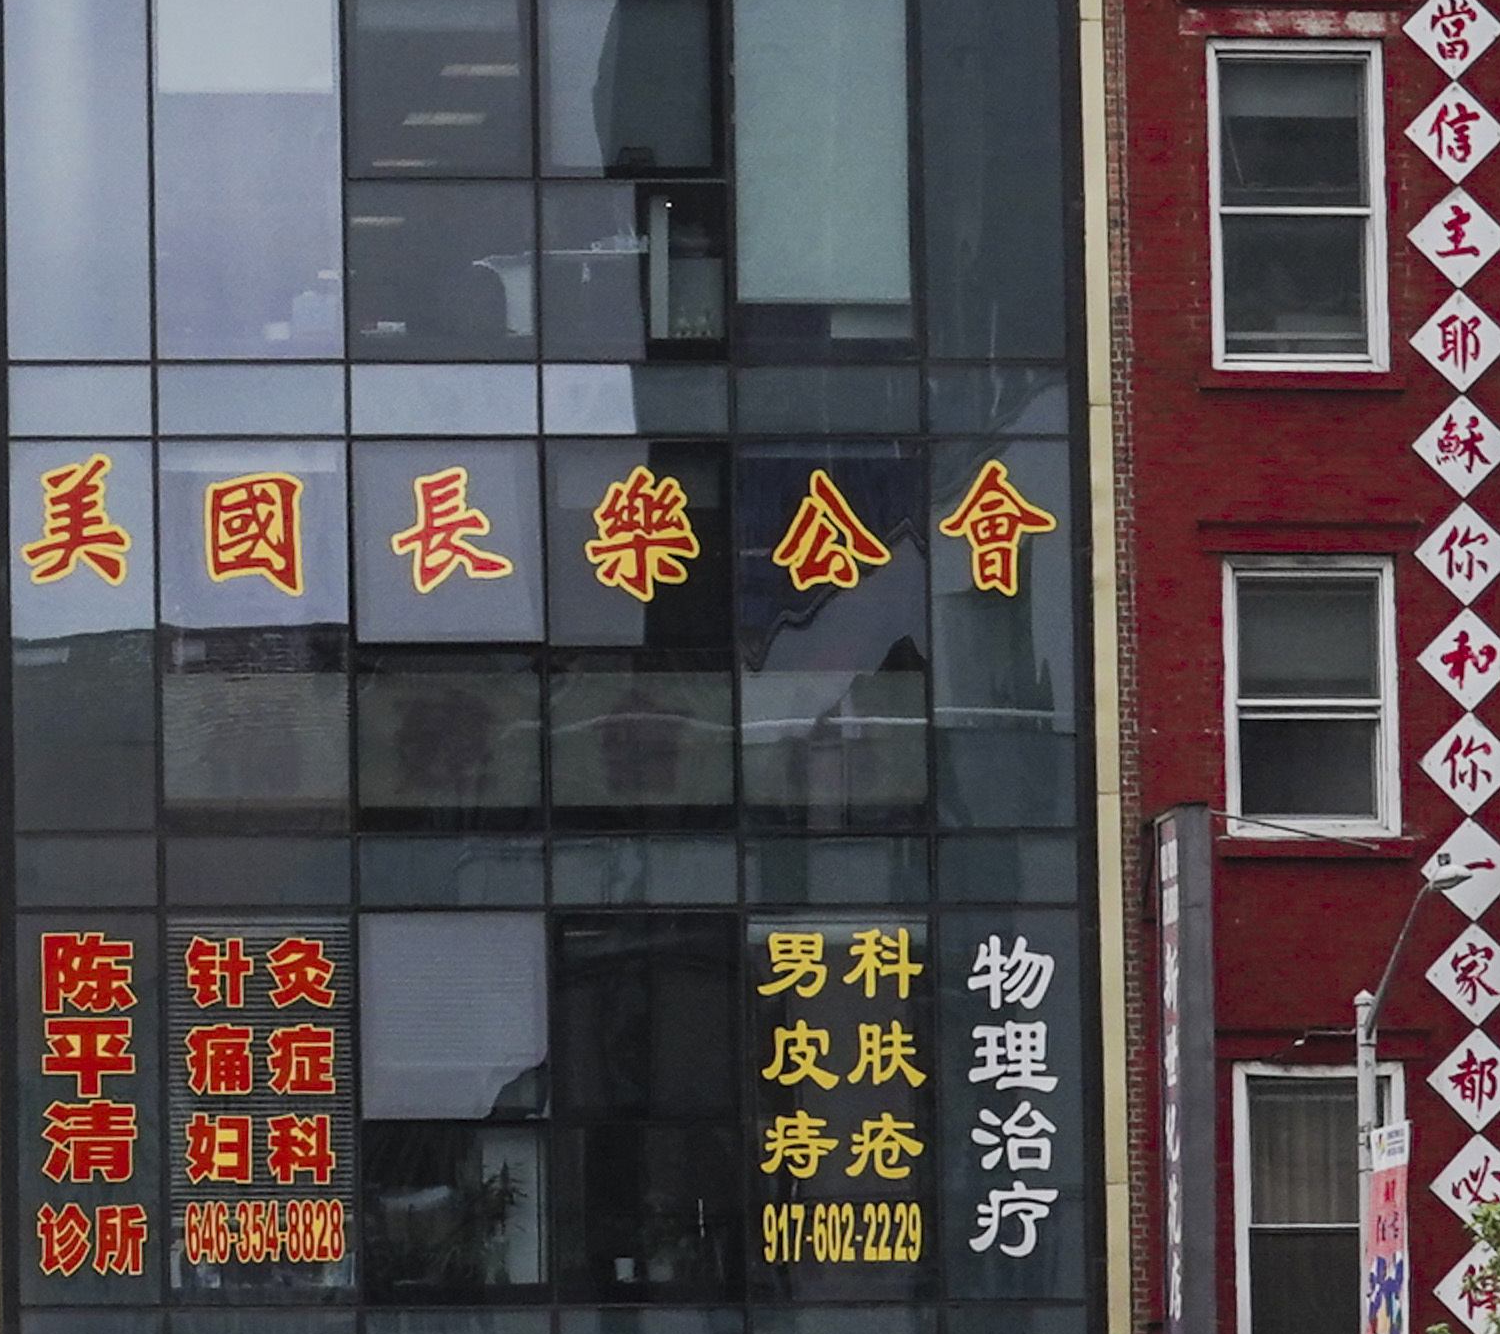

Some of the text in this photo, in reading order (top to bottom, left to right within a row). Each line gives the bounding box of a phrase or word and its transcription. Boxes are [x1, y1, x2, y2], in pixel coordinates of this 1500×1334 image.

[21, 452, 1058, 603] 美國長樂公會
[184, 935, 337, 1009] 针灸
[756, 927, 924, 1000] 男科
[40, 931, 138, 1183] 陈平清
[184, 1023, 337, 1095] 痛症
[761, 1019, 927, 1091] 皮肤
[967, 933, 1060, 1258] 物理治疗
[184, 1111, 337, 1185] 妇科
[760, 1109, 925, 1179] 痔疮
[36, 1202, 148, 1277] 诊所
[184, 1198, 344, 1265] 646-354-8828
[762, 1201, 923, 1263] 917-602-2229
